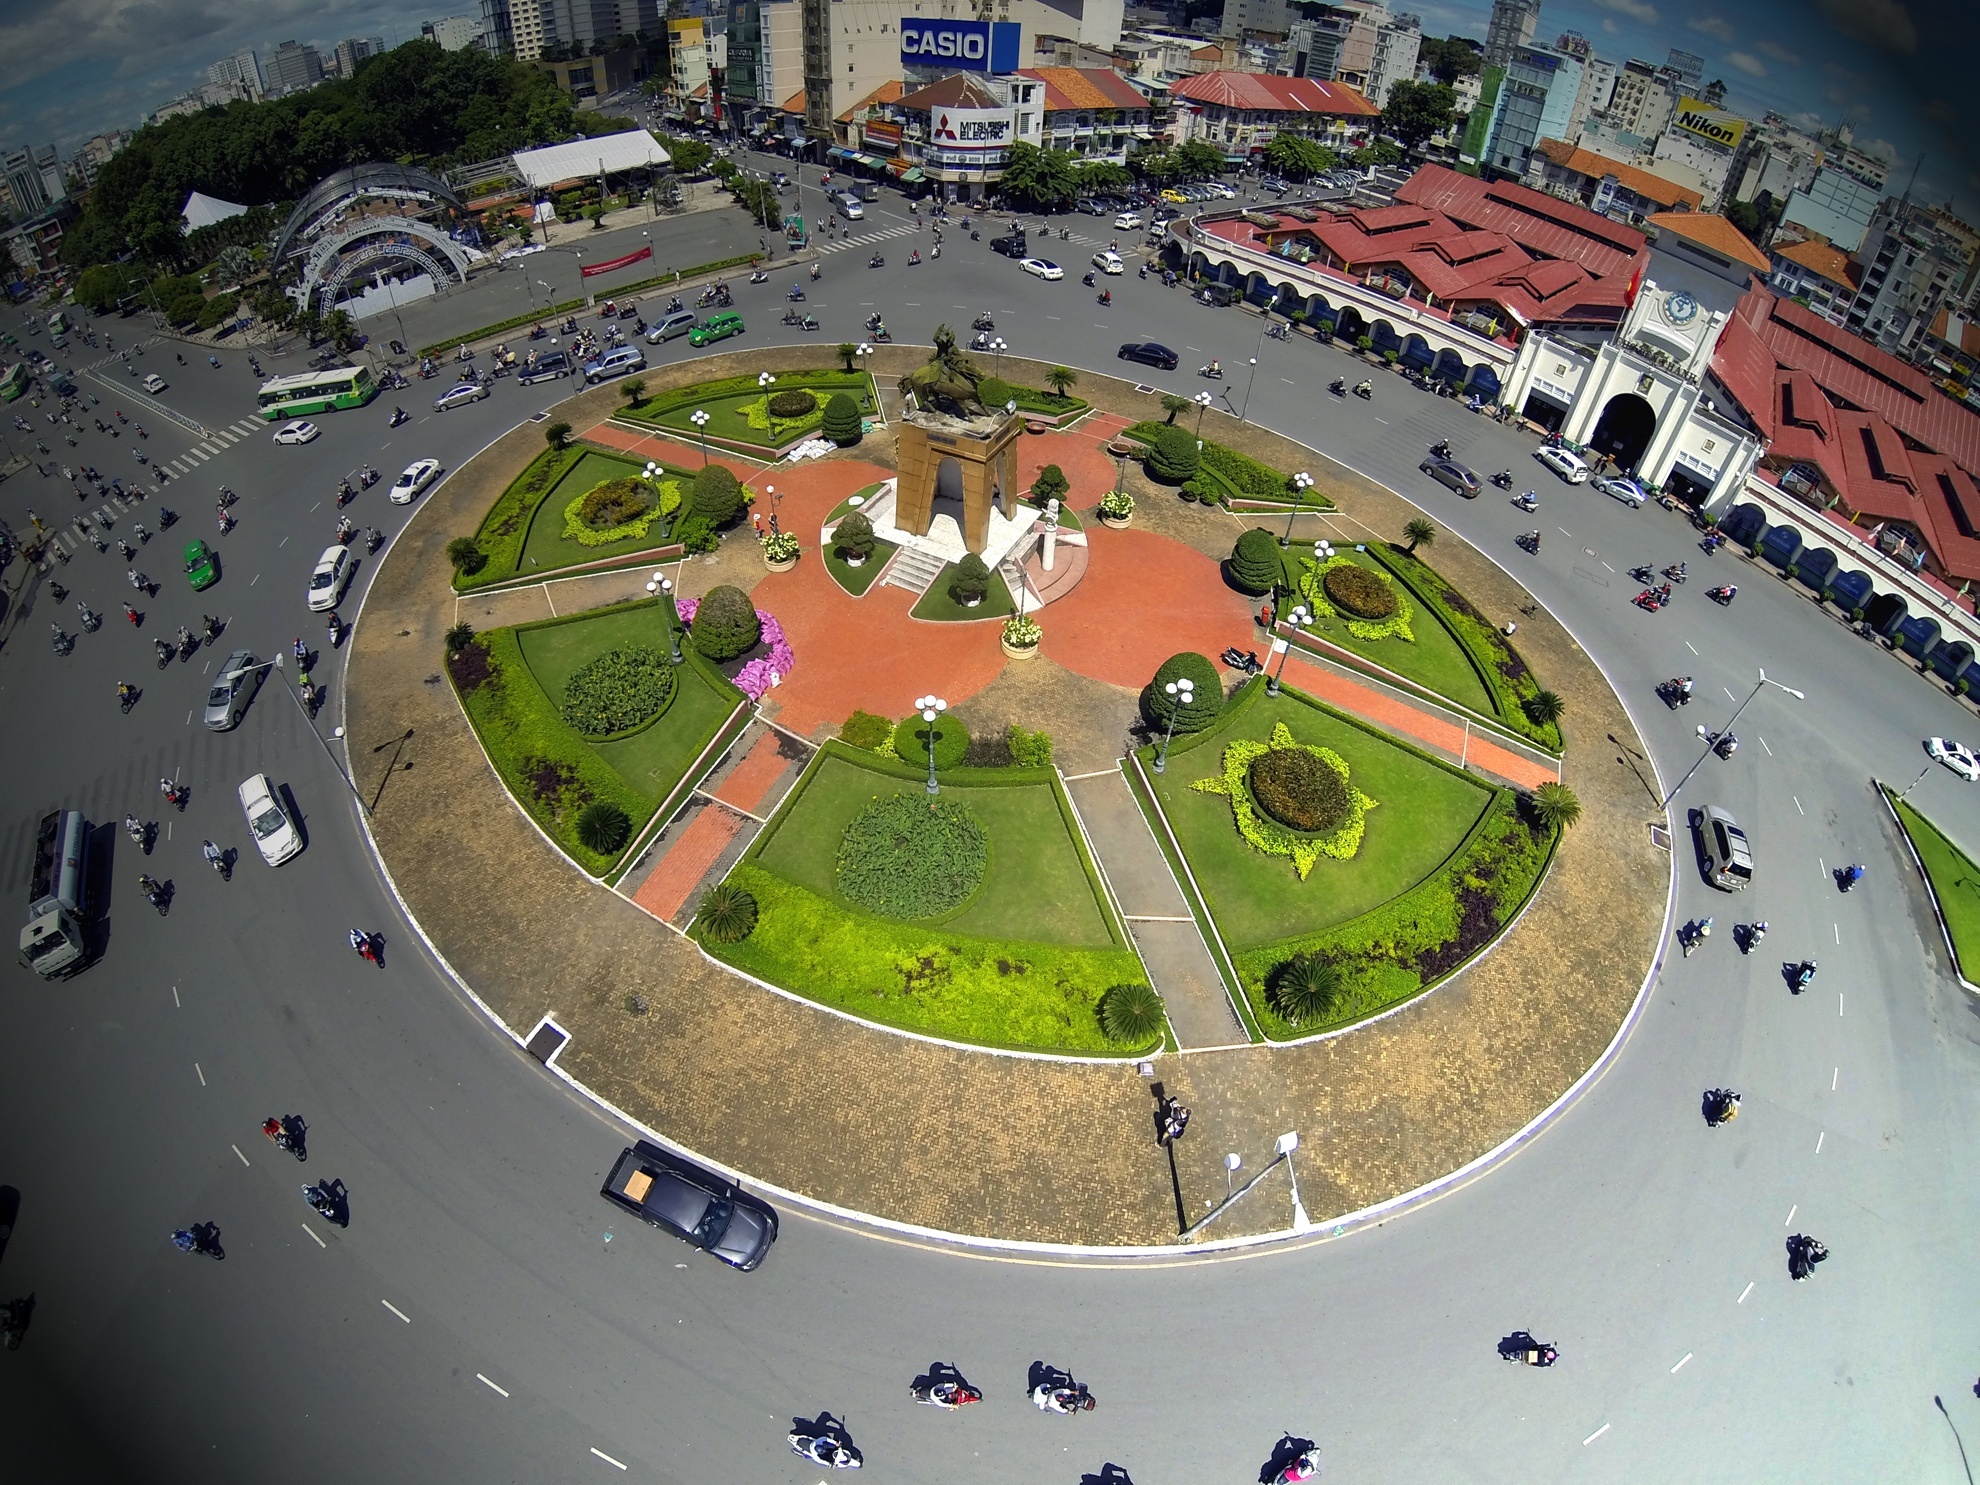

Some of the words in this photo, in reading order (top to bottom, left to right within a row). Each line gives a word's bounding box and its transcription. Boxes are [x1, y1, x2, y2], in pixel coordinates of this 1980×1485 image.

[901, 29, 985, 59] CASIO
[960, 121, 1010, 132] MITSUBISHI
[960, 130, 1004, 141] ELECTRIC
[1679, 111, 1734, 143] Nikon
